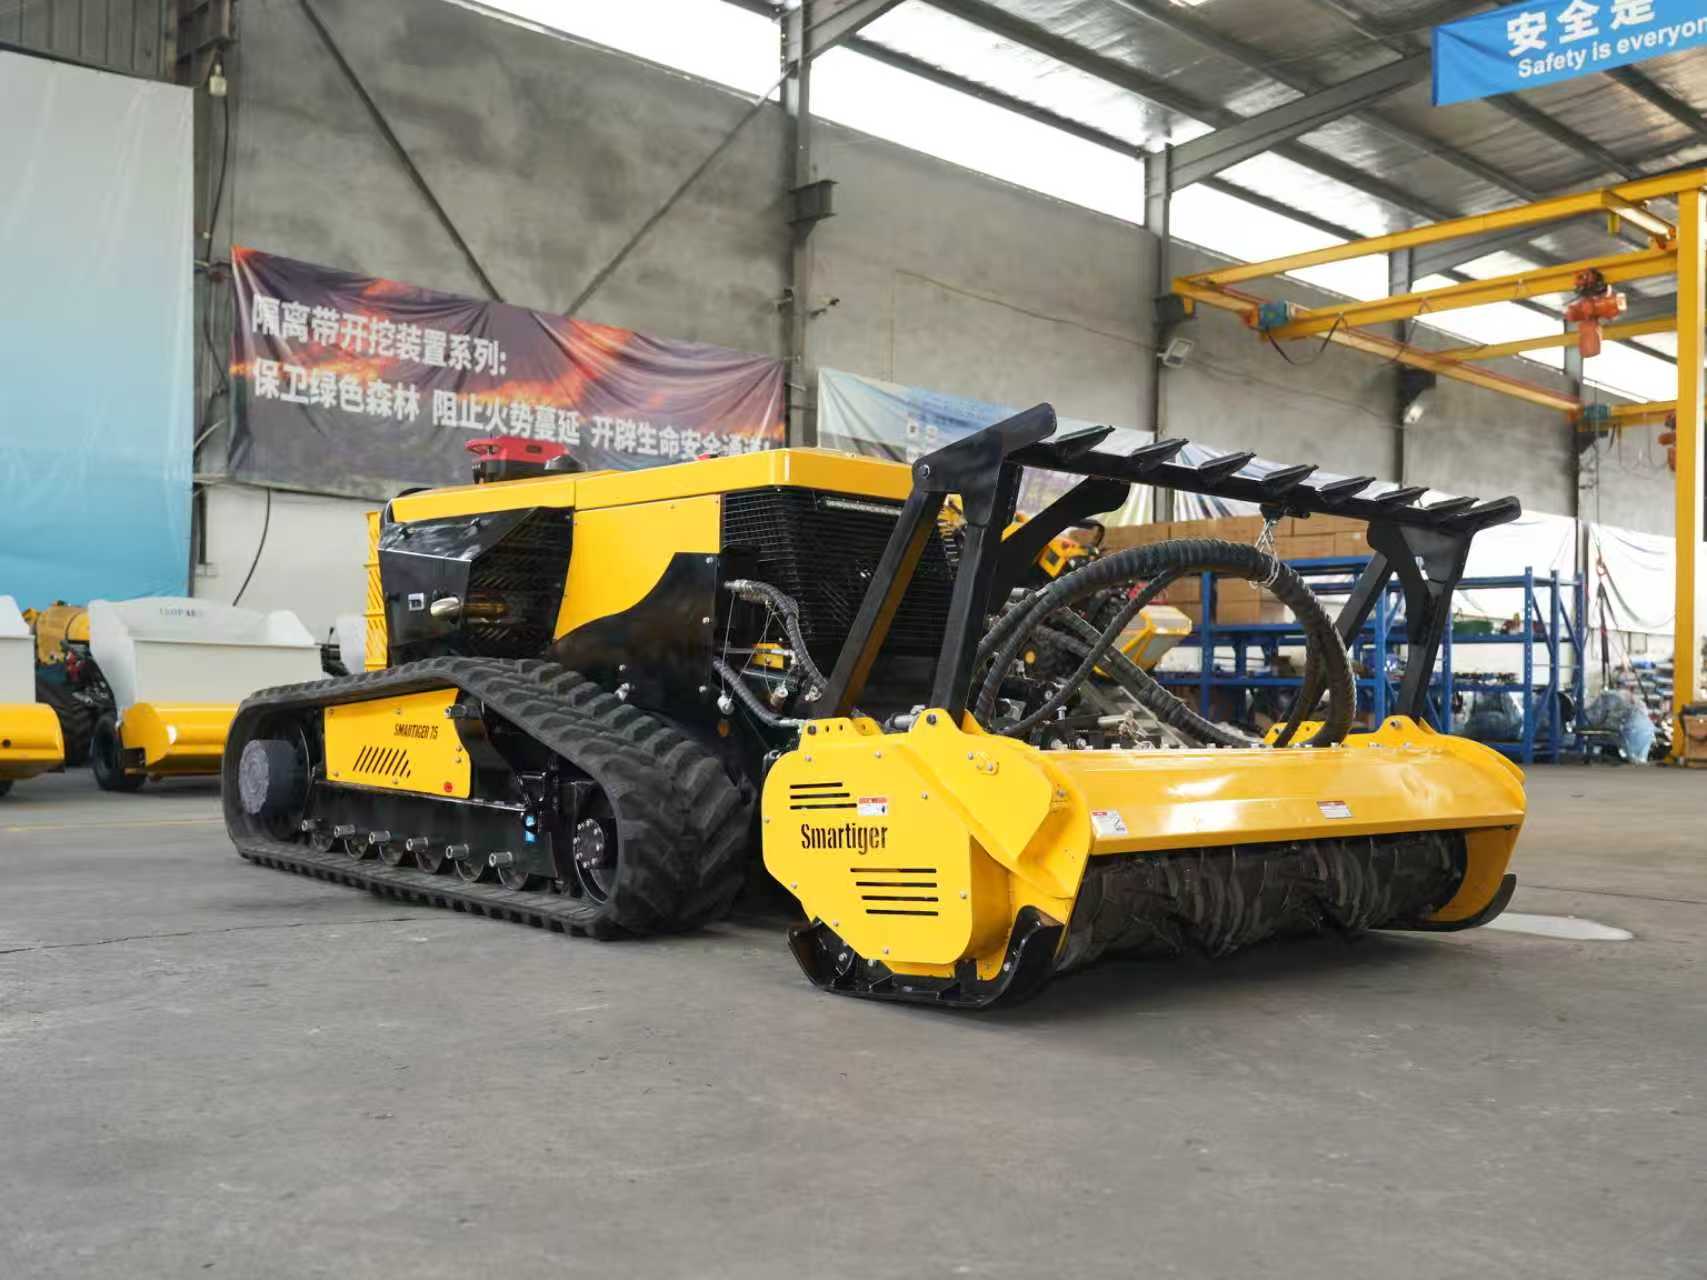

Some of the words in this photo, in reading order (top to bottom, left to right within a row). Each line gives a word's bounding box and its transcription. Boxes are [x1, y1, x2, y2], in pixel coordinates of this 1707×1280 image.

[1518, 48, 1587, 78] Safety
[1592, 41, 1612, 61] is
[254, 358, 420, 422] 保卫绿色森林
[432, 389, 581, 446] 阻止火势蔓延
[800, 822, 888, 855] Smartiger
